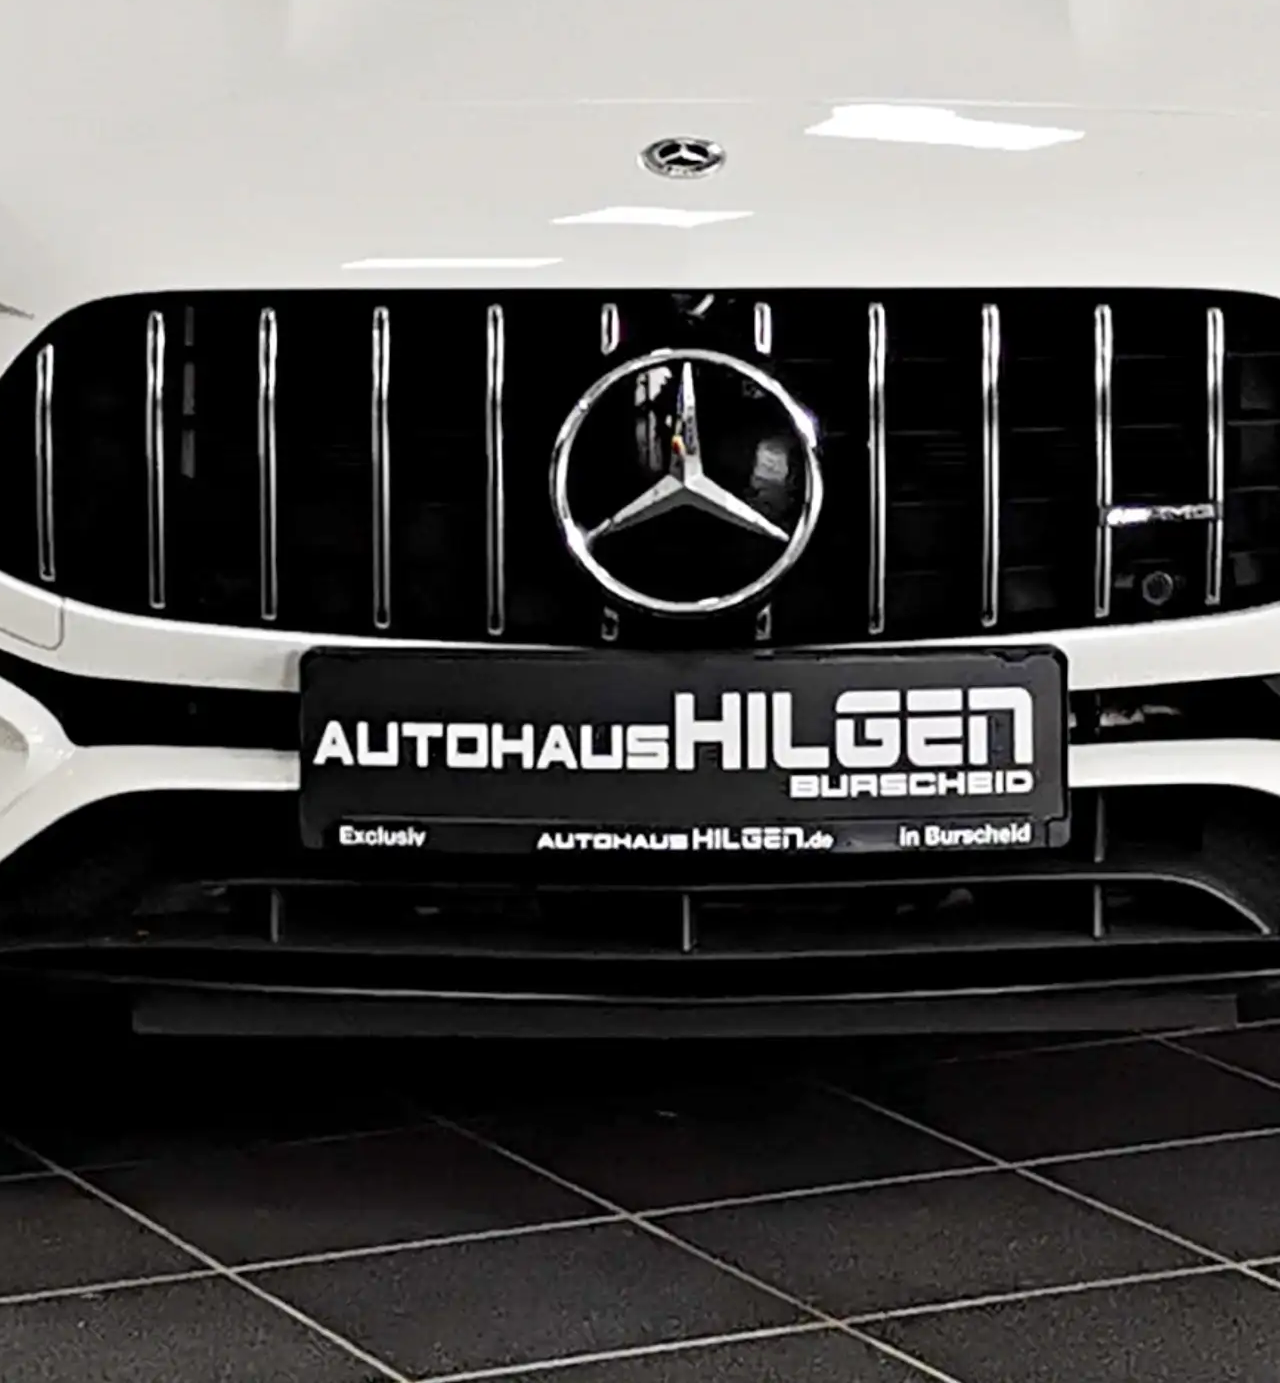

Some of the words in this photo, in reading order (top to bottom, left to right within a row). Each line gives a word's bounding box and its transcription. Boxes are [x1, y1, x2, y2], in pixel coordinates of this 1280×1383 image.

[790, 771, 1034, 798] BURSCHEID
[339, 825, 426, 847] Exclusiv
[899, 826, 920, 847] in
[924, 822, 1032, 847] Burscheid
